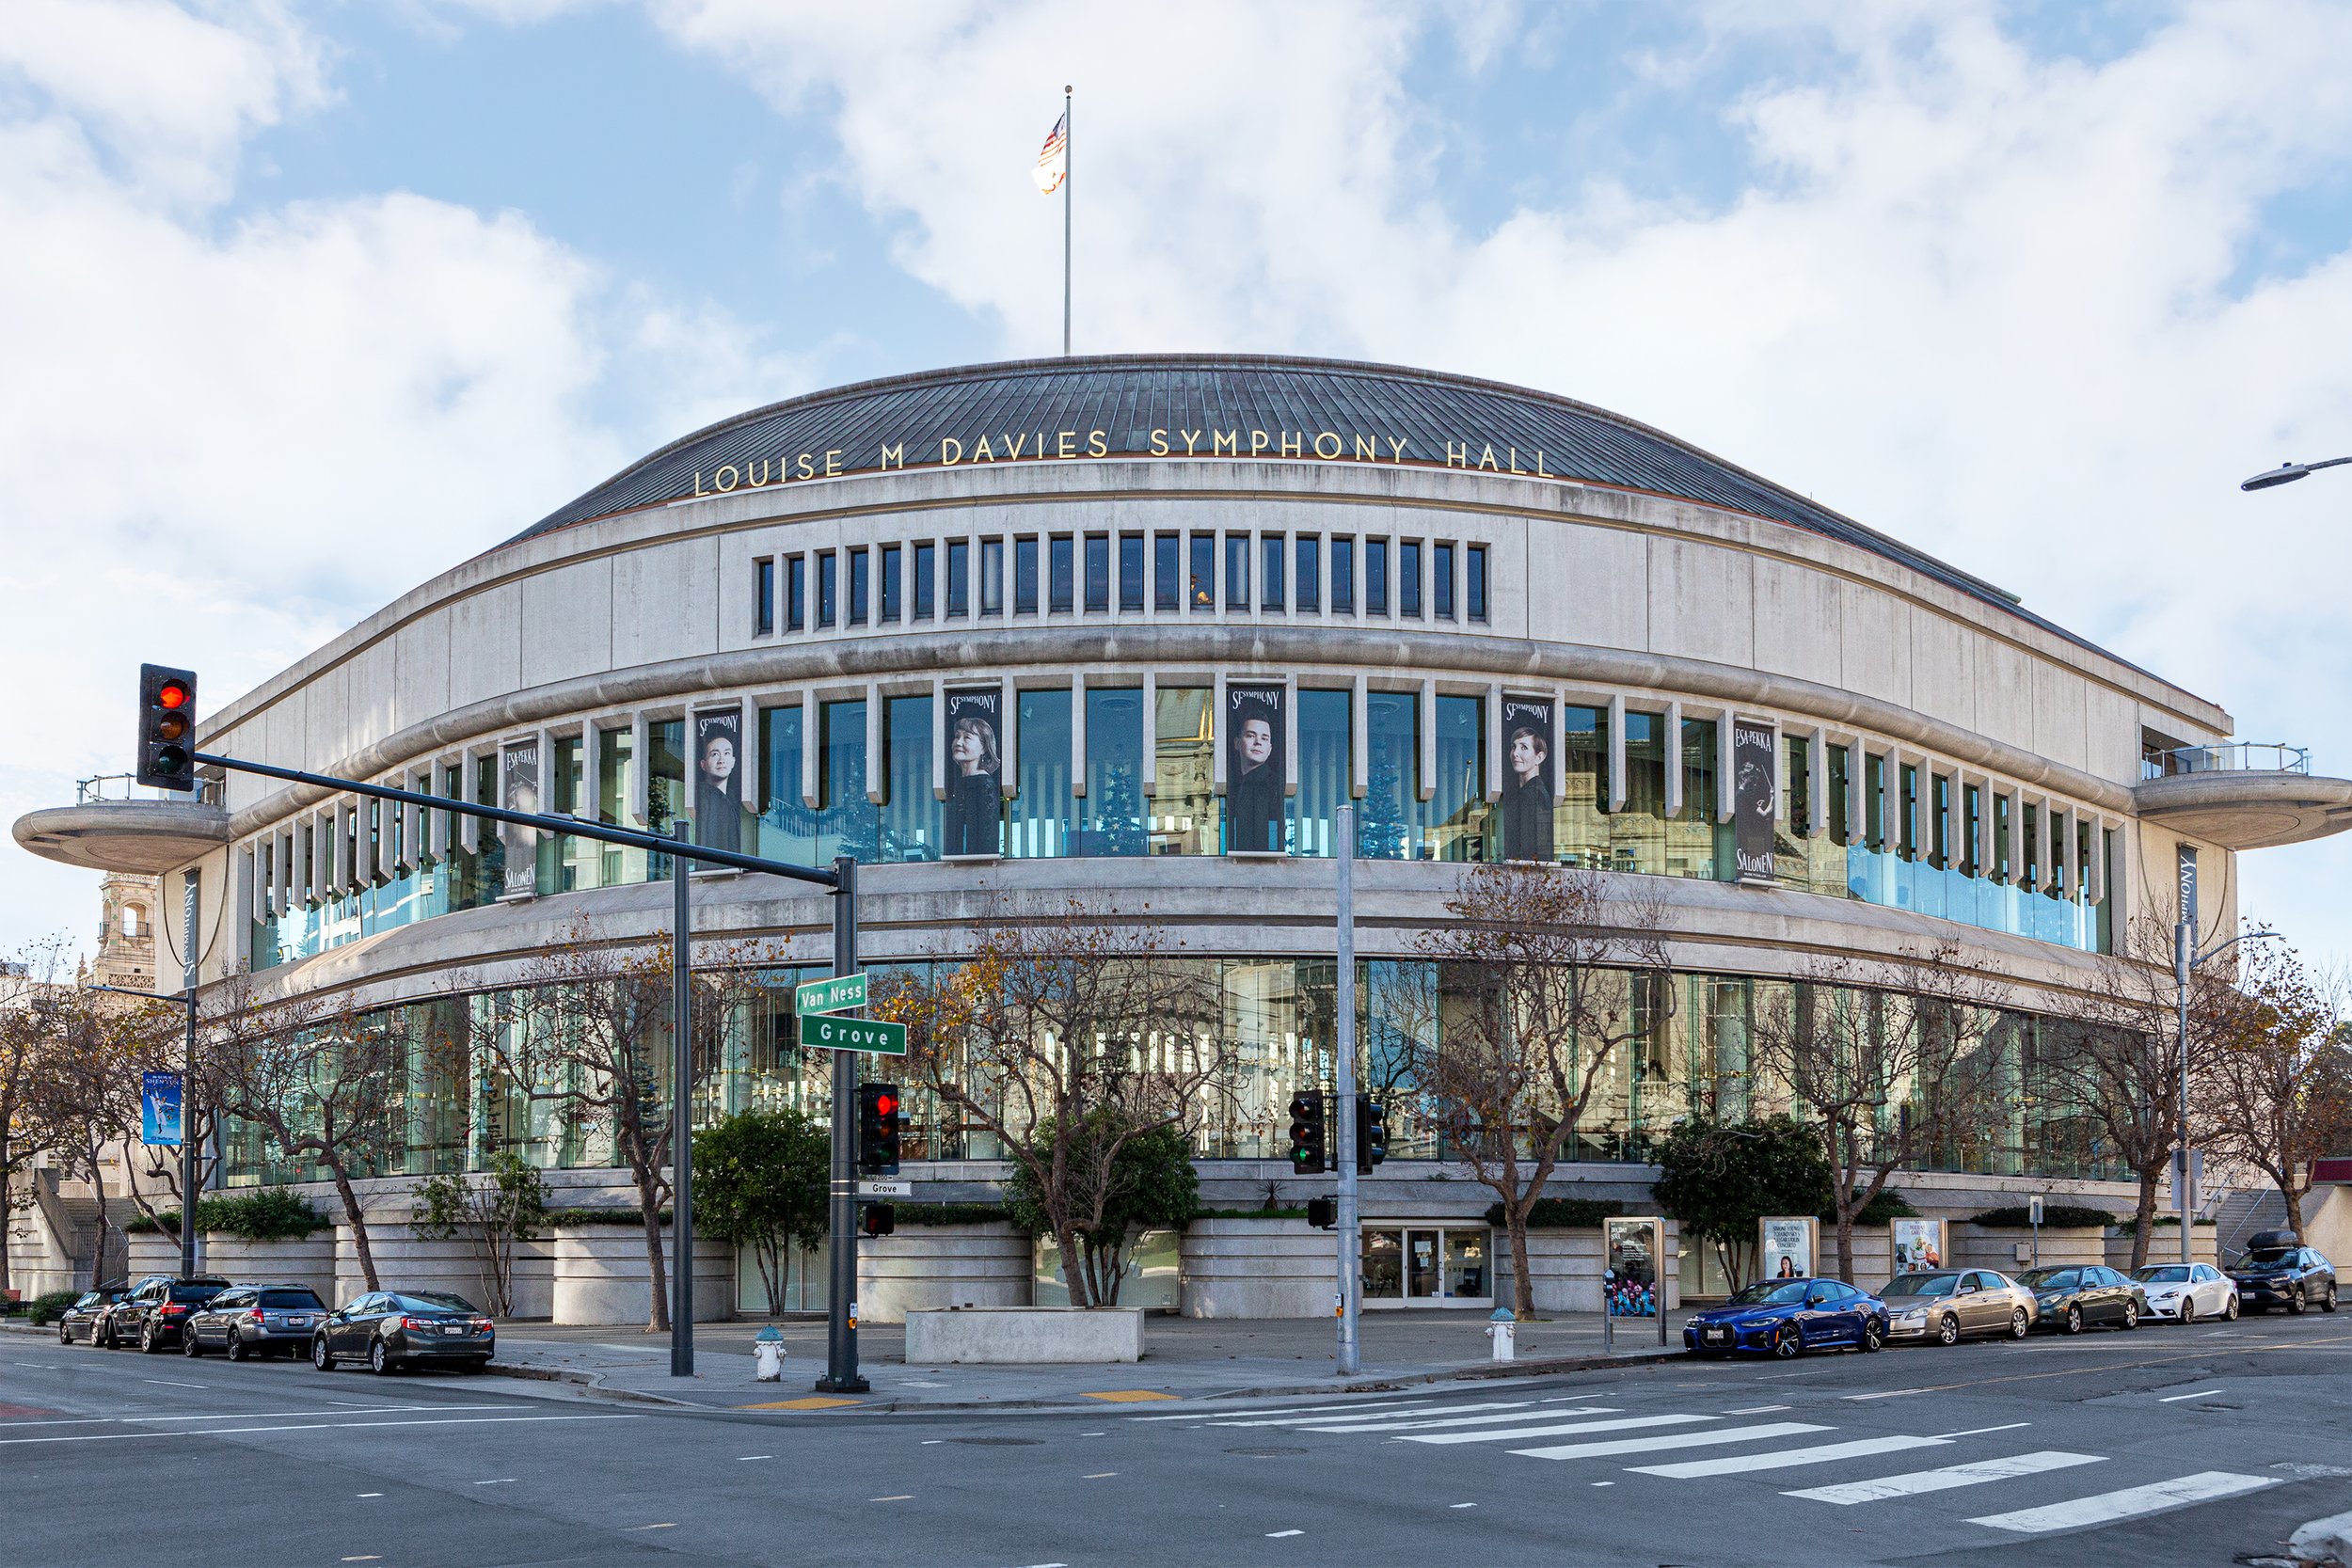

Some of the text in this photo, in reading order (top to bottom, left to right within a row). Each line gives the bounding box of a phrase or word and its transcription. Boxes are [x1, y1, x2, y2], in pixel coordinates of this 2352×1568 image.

[694, 429, 1554, 498] LOUISE M DAVIES SYMPHONY HALL
[1735, 728, 1772, 752] ESA-PEKKA
[506, 747, 537, 771] ESA-PEKKA
[1737, 847, 1773, 874] SALONEN
[504, 863, 535, 889] SALONEN
[801, 983, 862, 1008] Van Ness
[820, 1022, 888, 1046] Grove
[872, 1183, 898, 1193] Grove
